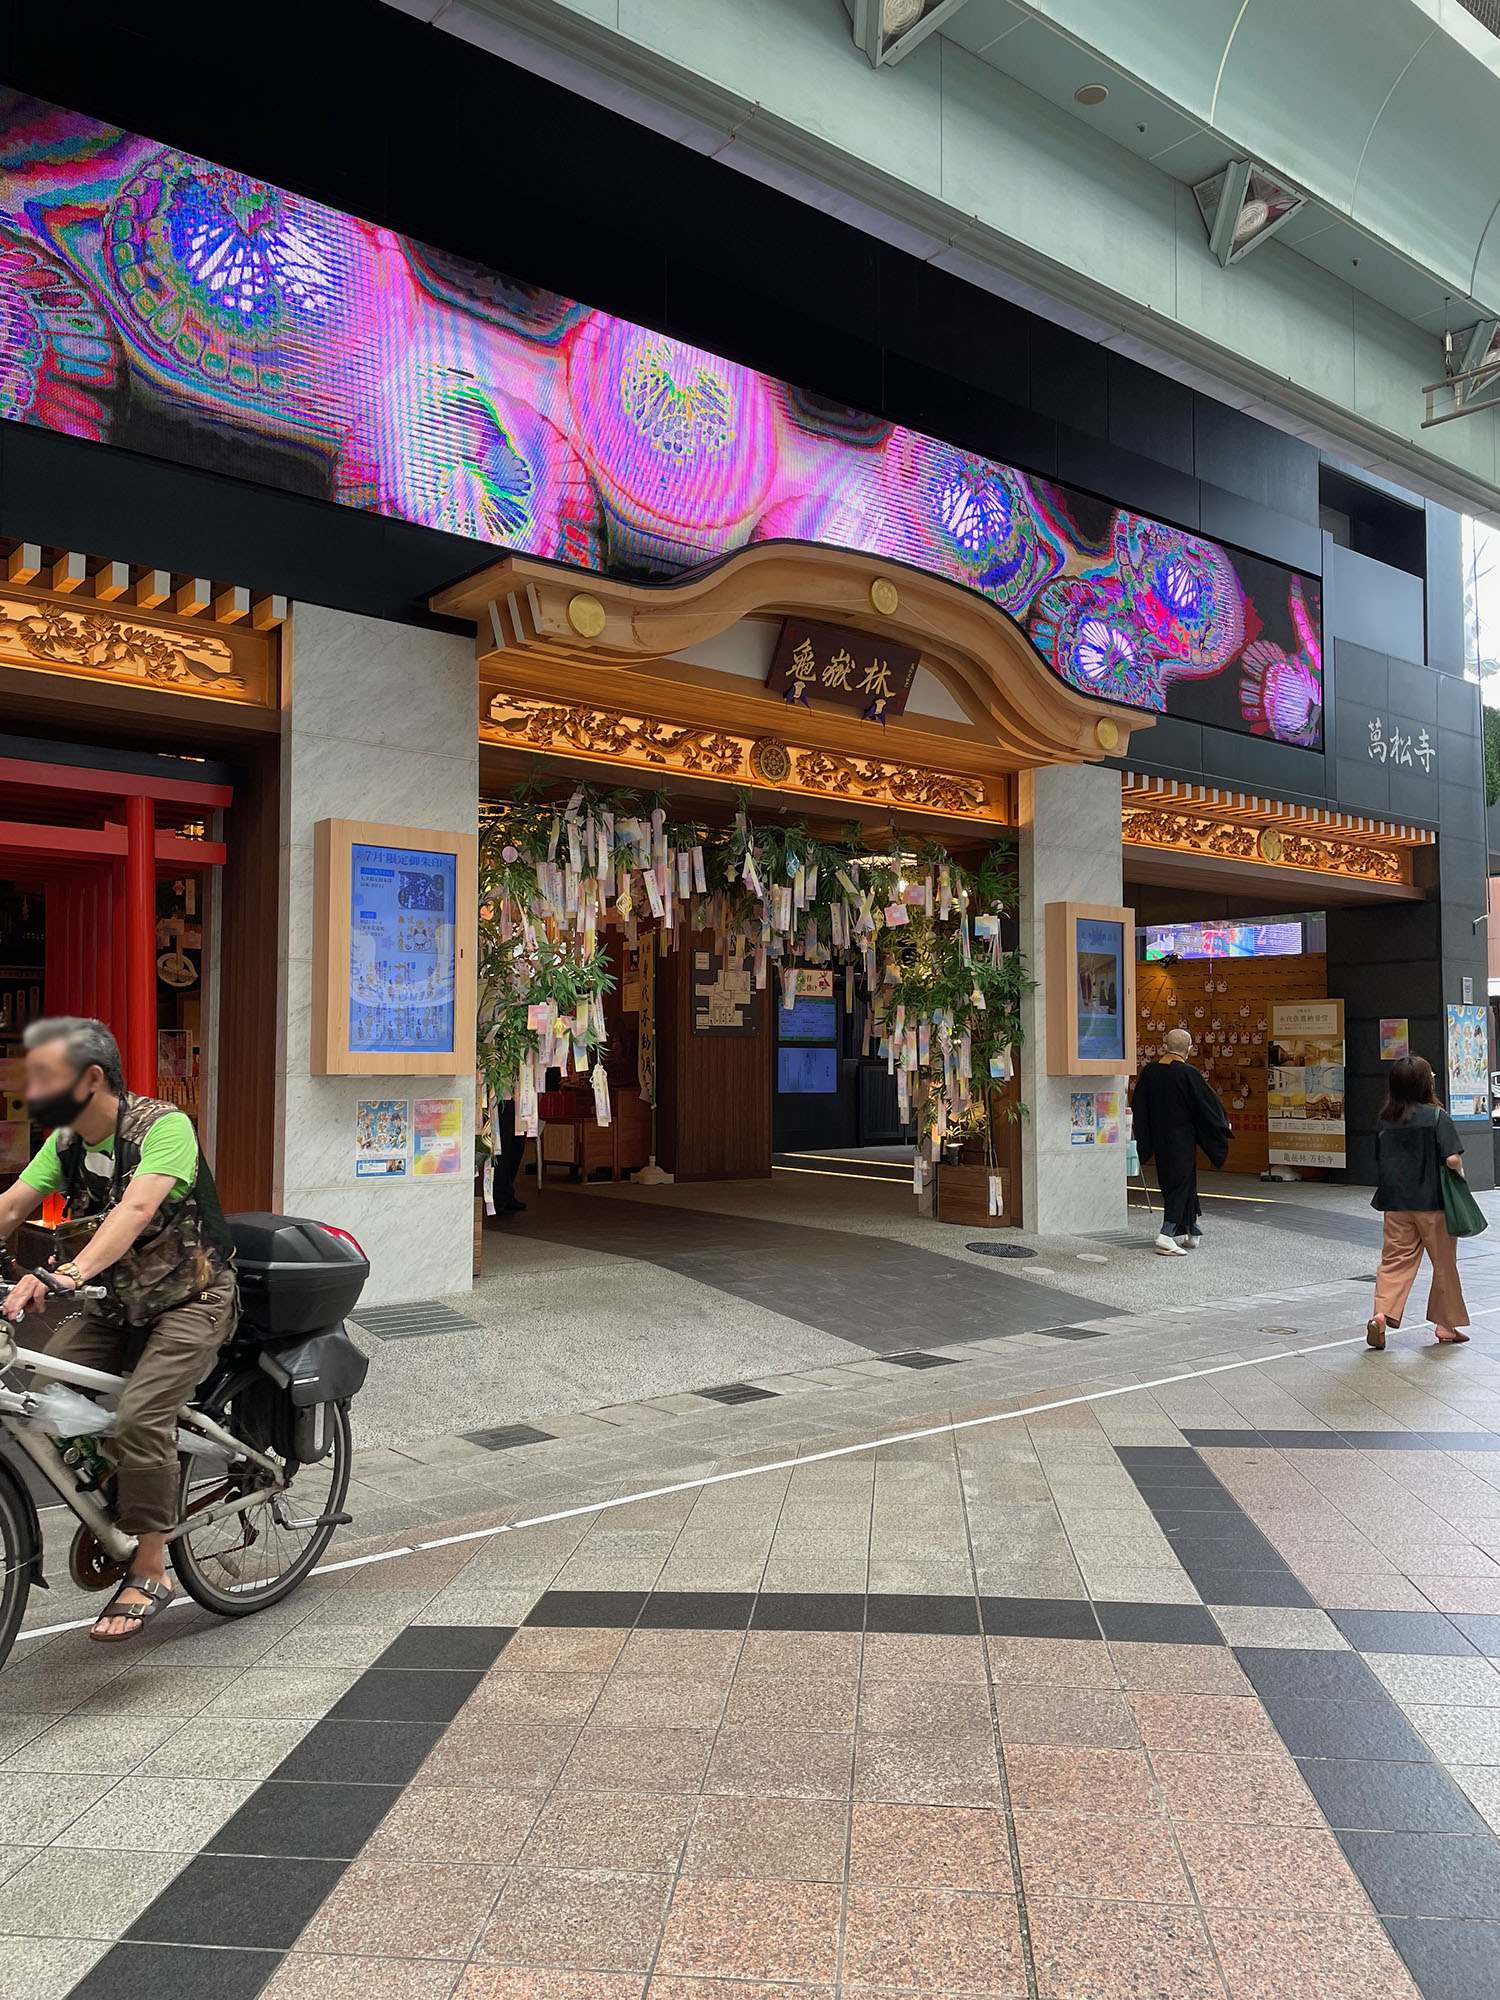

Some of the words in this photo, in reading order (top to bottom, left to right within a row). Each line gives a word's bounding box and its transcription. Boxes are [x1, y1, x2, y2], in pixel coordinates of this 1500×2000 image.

[1367, 716, 1436, 774] 萬松寺
[365, 850, 443, 868] 7月限定御朱印
